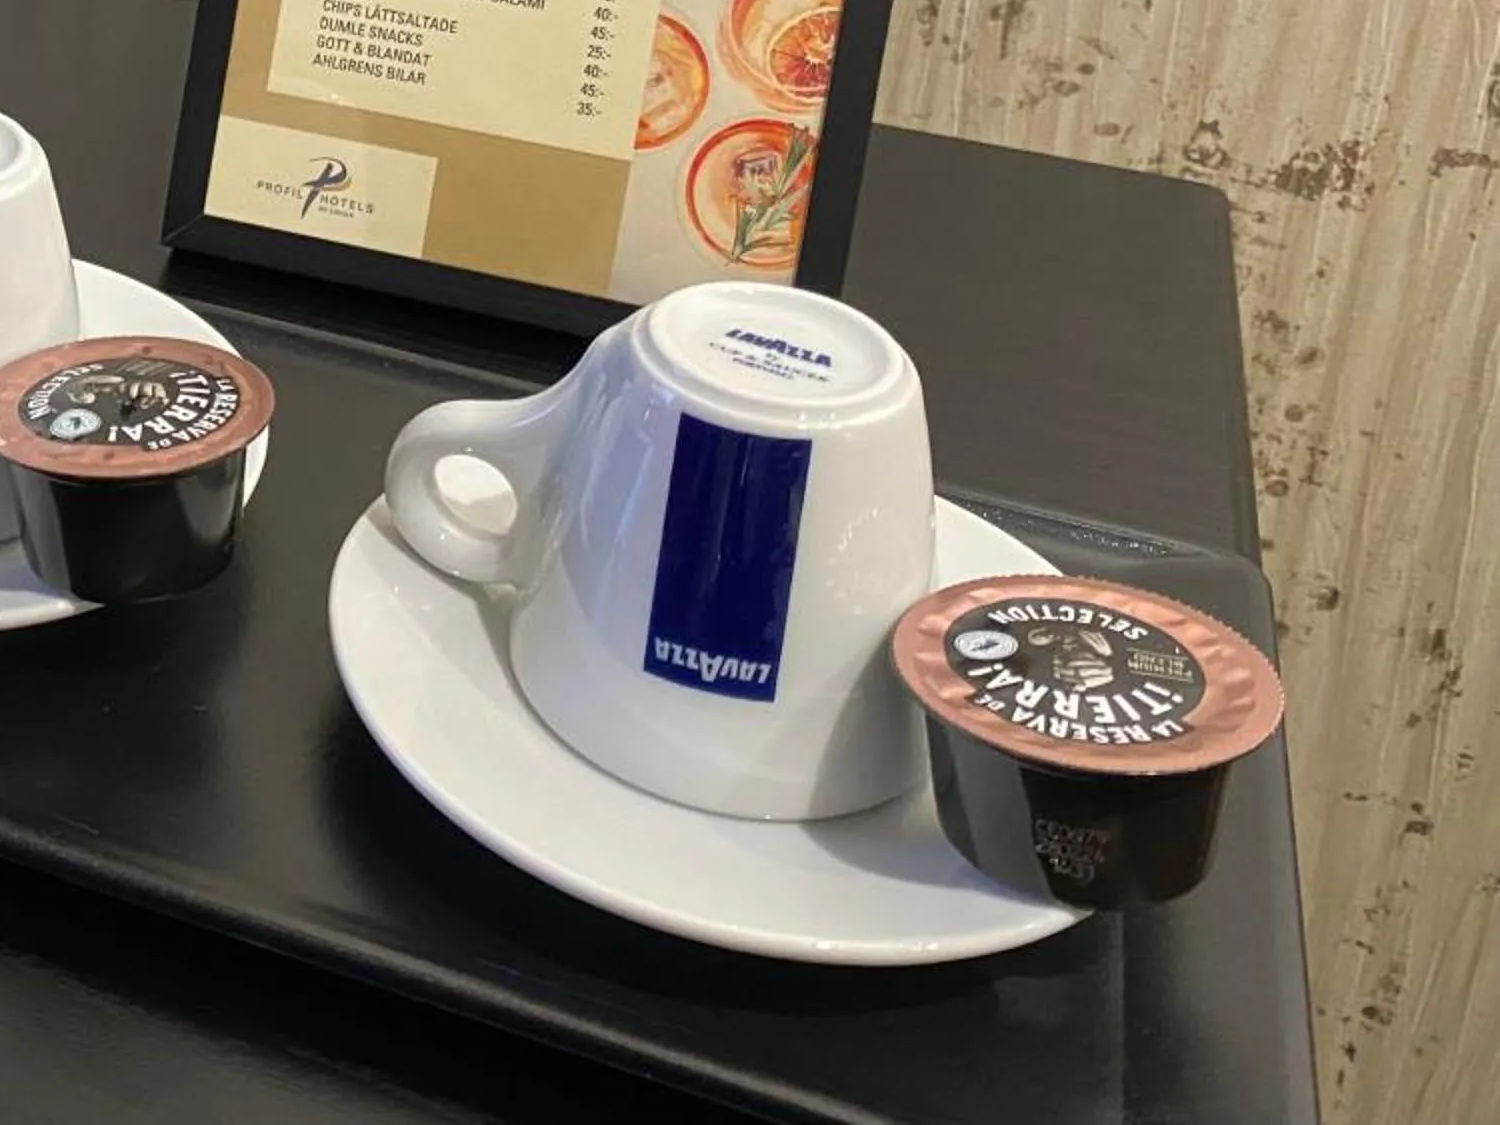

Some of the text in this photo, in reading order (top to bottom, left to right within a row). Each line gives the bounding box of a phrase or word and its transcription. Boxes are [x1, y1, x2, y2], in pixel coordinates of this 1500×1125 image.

[323, 0, 362, 17] CHIPS
[320, 16, 423, 47] DUMLE SNACKS
[316, 34, 432, 67] GOTT & BLANDAT
[312, 53, 426, 85] AHLGRENS BILAR
[257, 180, 303, 200] PROFIL
[320, 194, 374, 213] HOTELS
[725, 329, 832, 367] LAVAZZA
[171, 393, 237, 442] RESERVA
[987, 604, 1148, 641] SELECTION
[655, 636, 771, 683] LAVAZZA
[974, 694, 1184, 744] LA RESERVA DE
